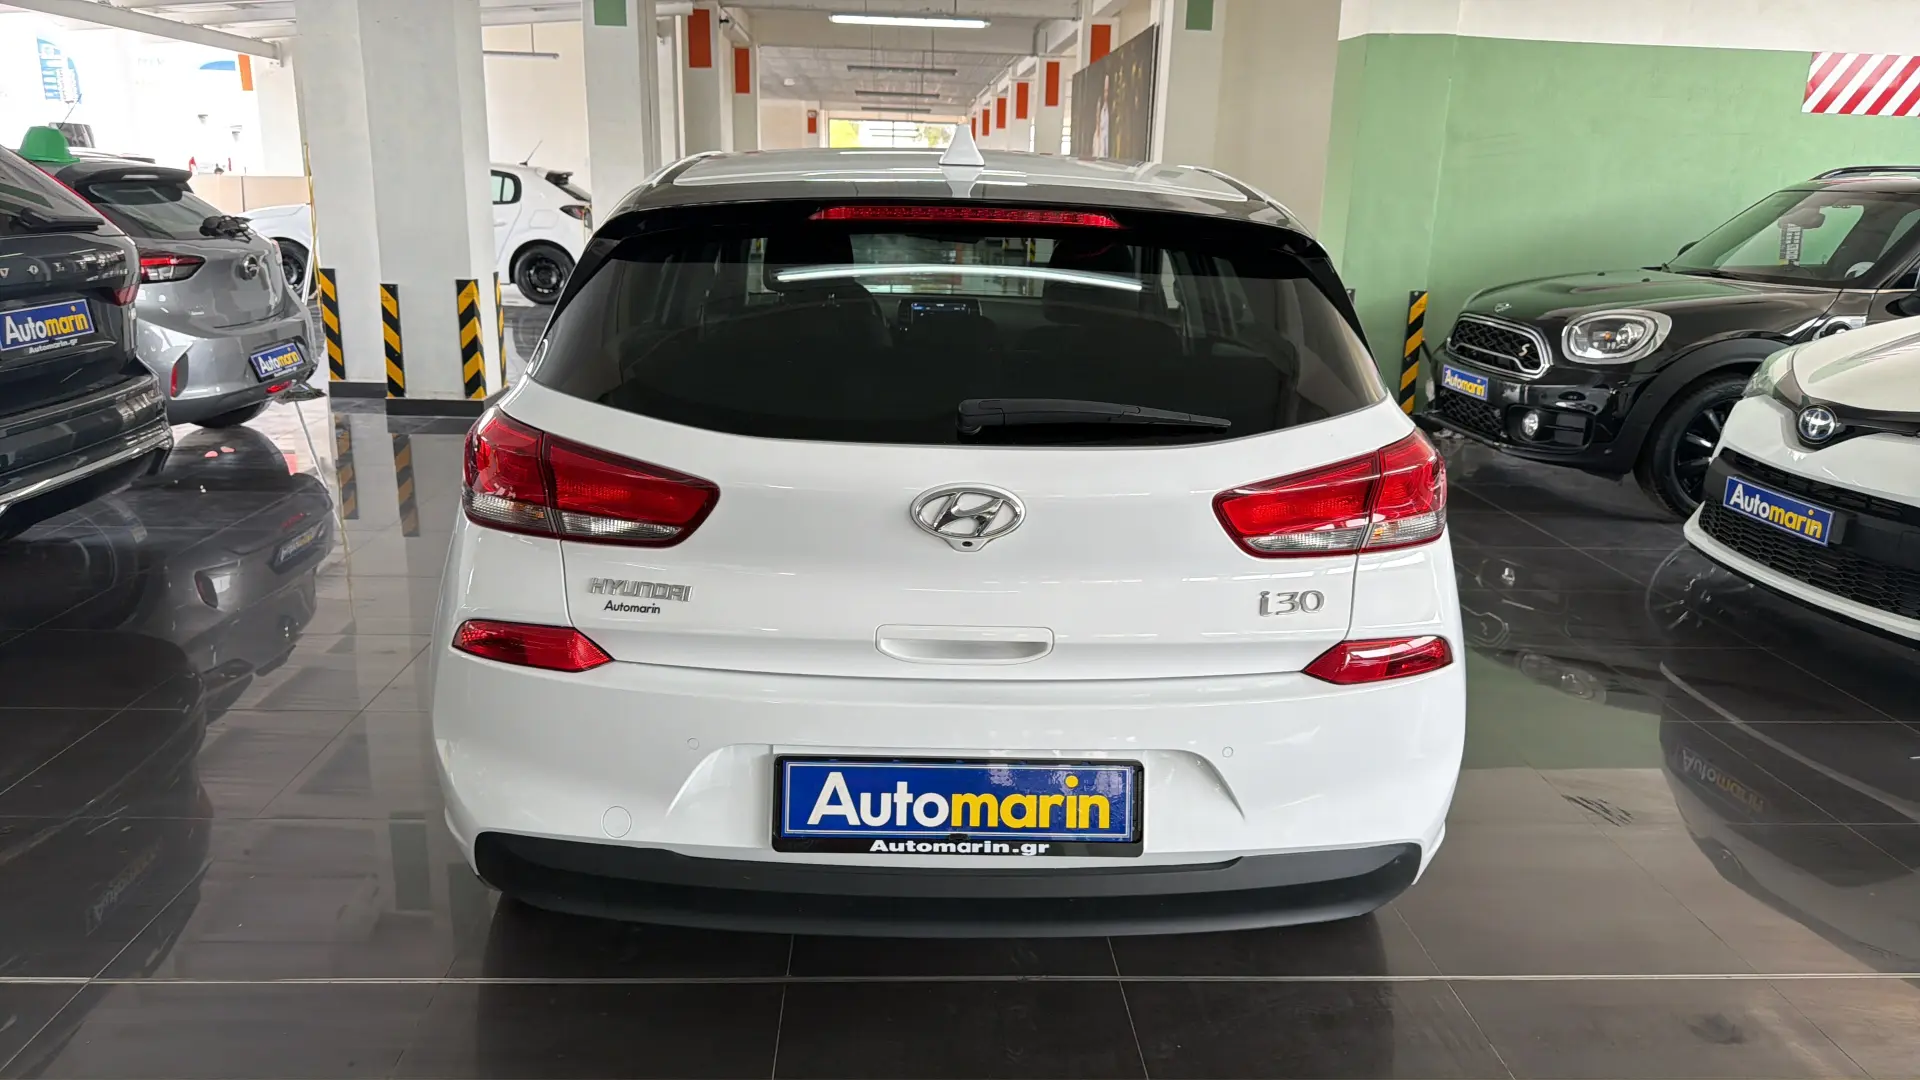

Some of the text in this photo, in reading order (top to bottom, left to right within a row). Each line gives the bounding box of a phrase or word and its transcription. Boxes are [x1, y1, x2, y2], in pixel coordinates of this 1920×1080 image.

[5, 305, 89, 345] Automarin
[28, 338, 78, 354] Automarin.gr
[256, 347, 300, 374] Automarin
[1444, 369, 1486, 397] Automarin
[1728, 483, 1823, 539] Automarin
[588, 577, 694, 602] HYUNDAI
[603, 600, 661, 614] Automarin
[1259, 590, 1325, 617] i30
[806, 771, 1110, 829] Automarin
[869, 839, 1050, 857] Automarin.gr
